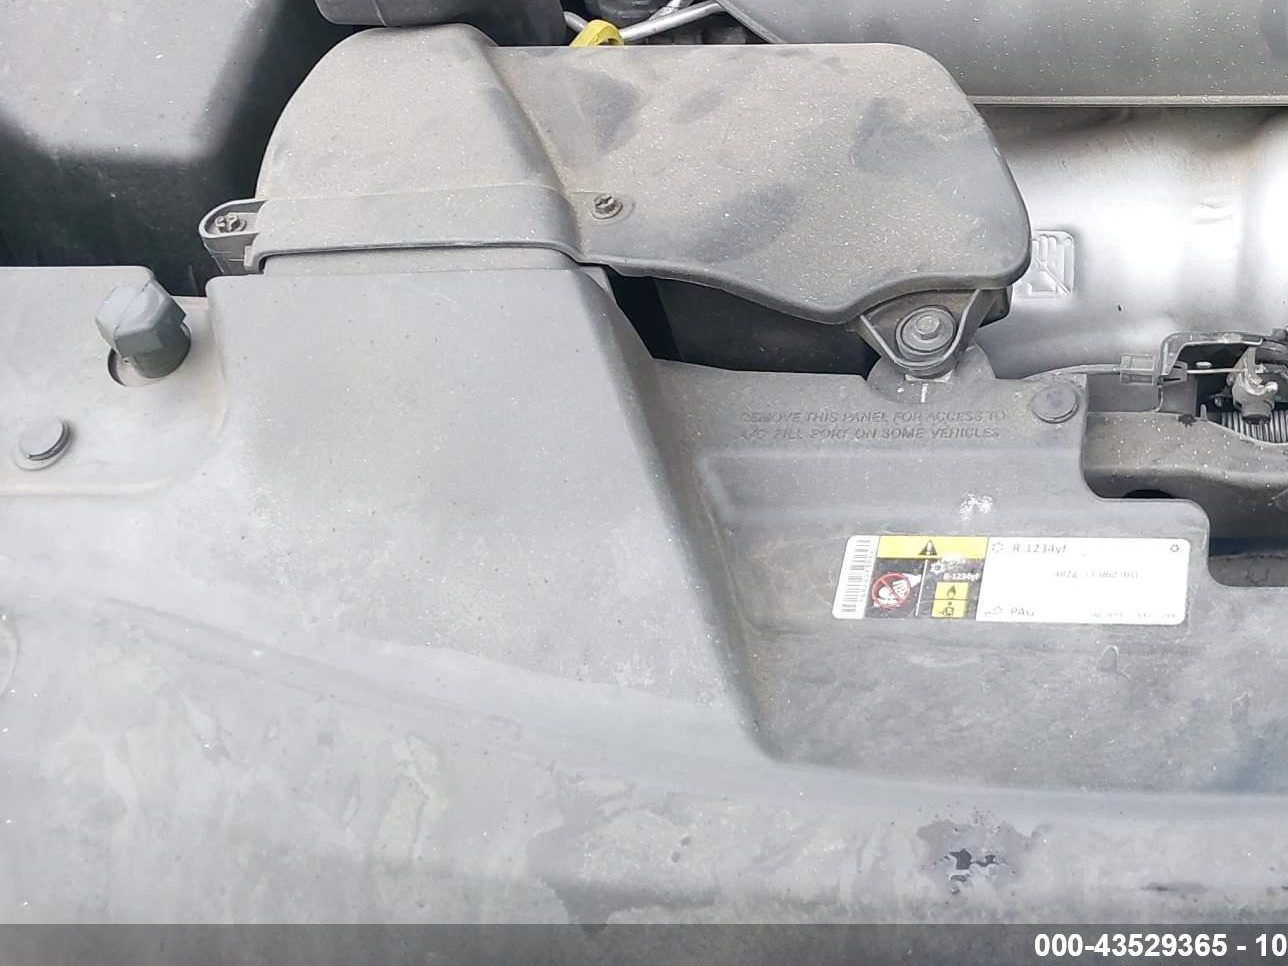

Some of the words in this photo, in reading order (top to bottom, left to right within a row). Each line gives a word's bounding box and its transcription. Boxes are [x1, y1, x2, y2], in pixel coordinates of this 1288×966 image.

[806, 410, 838, 423] THIS
[842, 410, 888, 423] PANEL
[893, 410, 922, 423] FOR
[855, 427, 878, 440] ON
[930, 427, 1002, 440] VEHICLES
